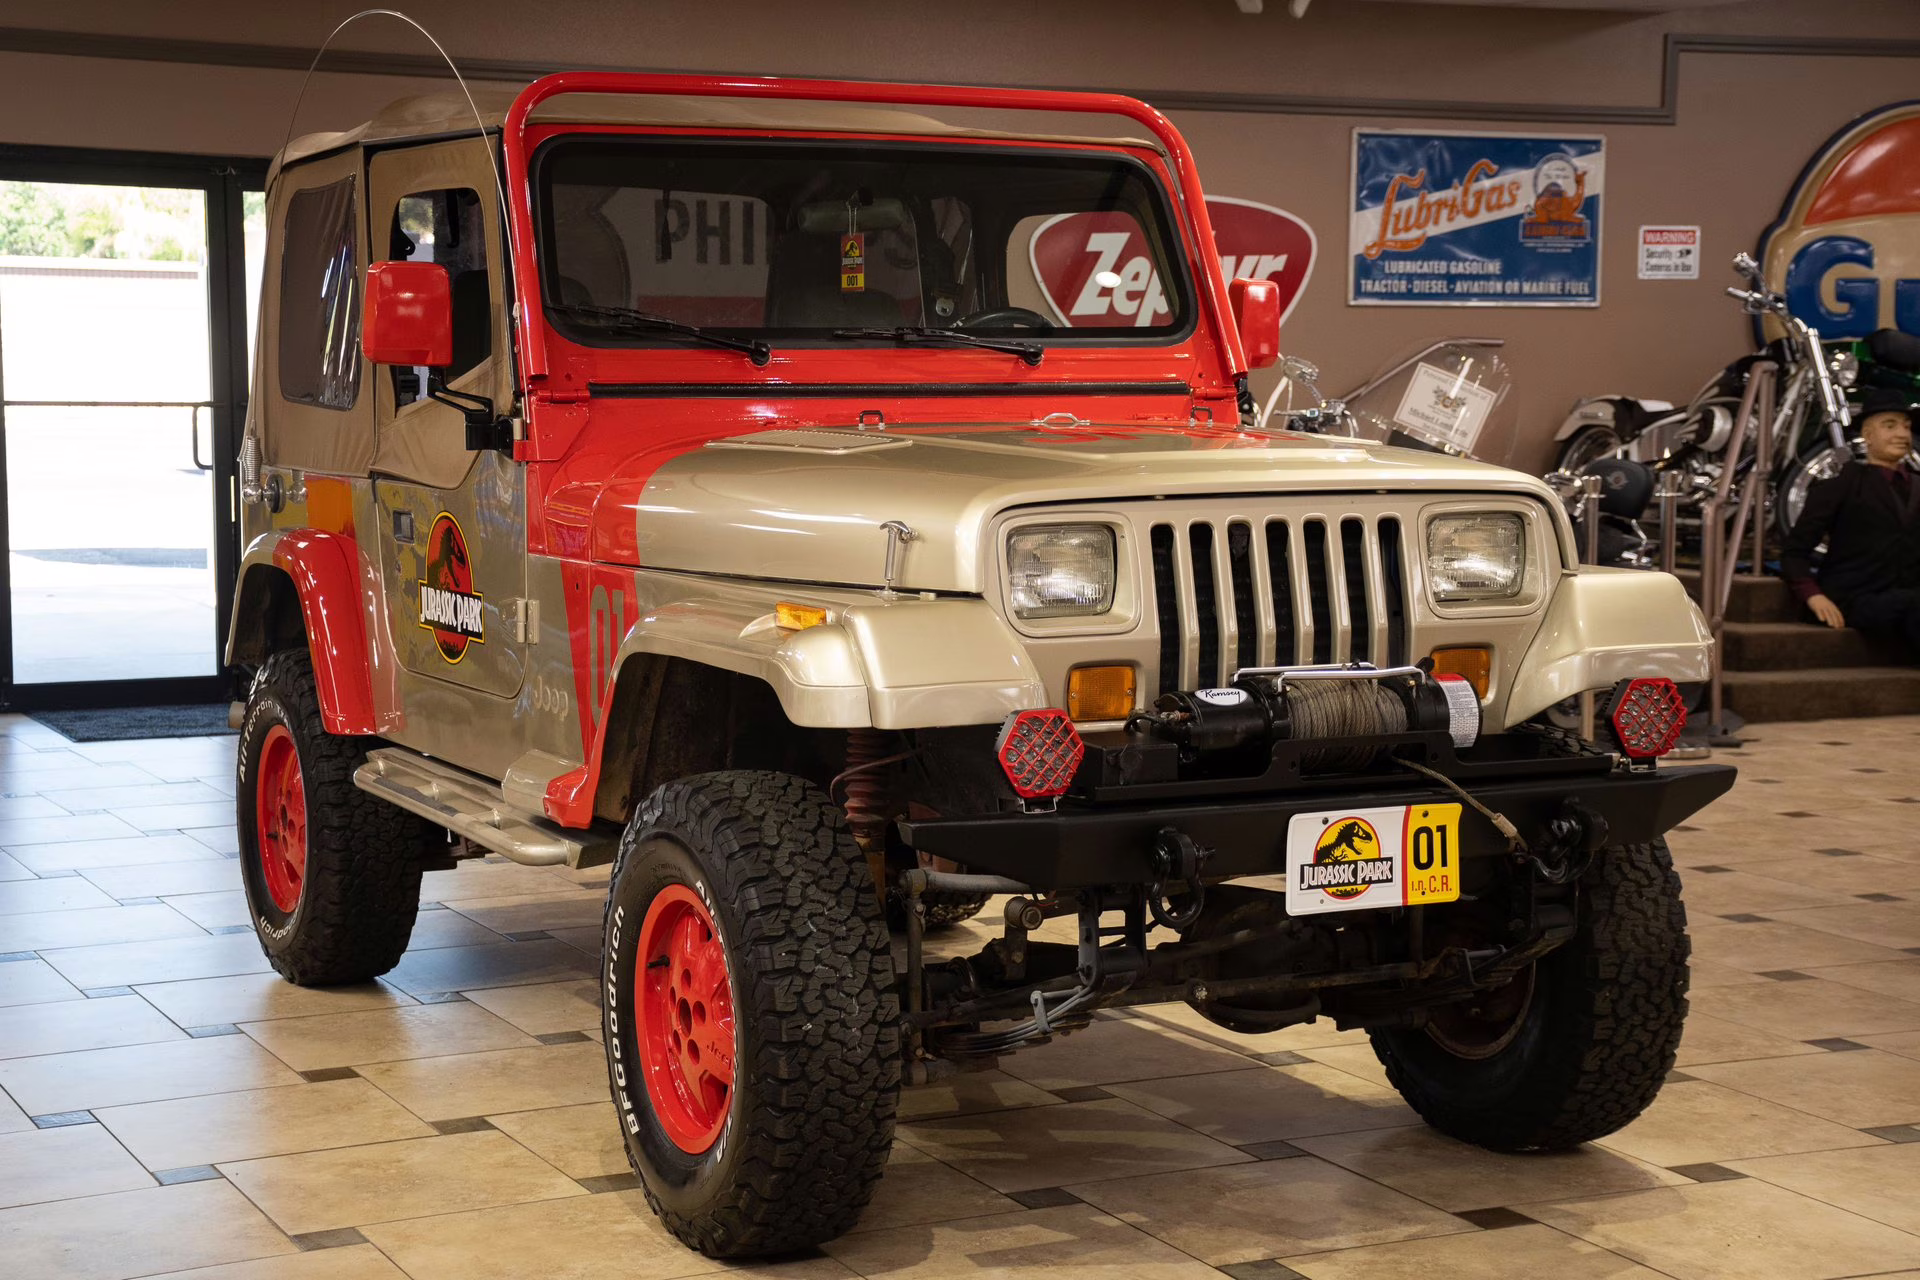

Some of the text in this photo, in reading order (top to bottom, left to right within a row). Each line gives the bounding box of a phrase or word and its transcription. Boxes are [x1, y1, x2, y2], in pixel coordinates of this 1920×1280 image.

[655, 199, 769, 265] PHI
[1644, 231, 1696, 243] WARNING
[1646, 248, 1673, 259] Security
[1384, 260, 1502, 274] LUBRICATED GASOLINE
[847, 275, 859, 286] 001
[1070, 230, 1288, 327] Zepyr
[1360, 280, 1590, 294] TRACTOR DIESEL AVIATION OR MARINE FUEL
[420, 585, 483, 633] JURASSIC PARK
[1200, 689, 1241, 703] Ramsey
[1413, 825, 1449, 870] 01
[1301, 859, 1393, 890] JURASSIC PARK
[606, 905, 641, 1136] BFGoodrich
